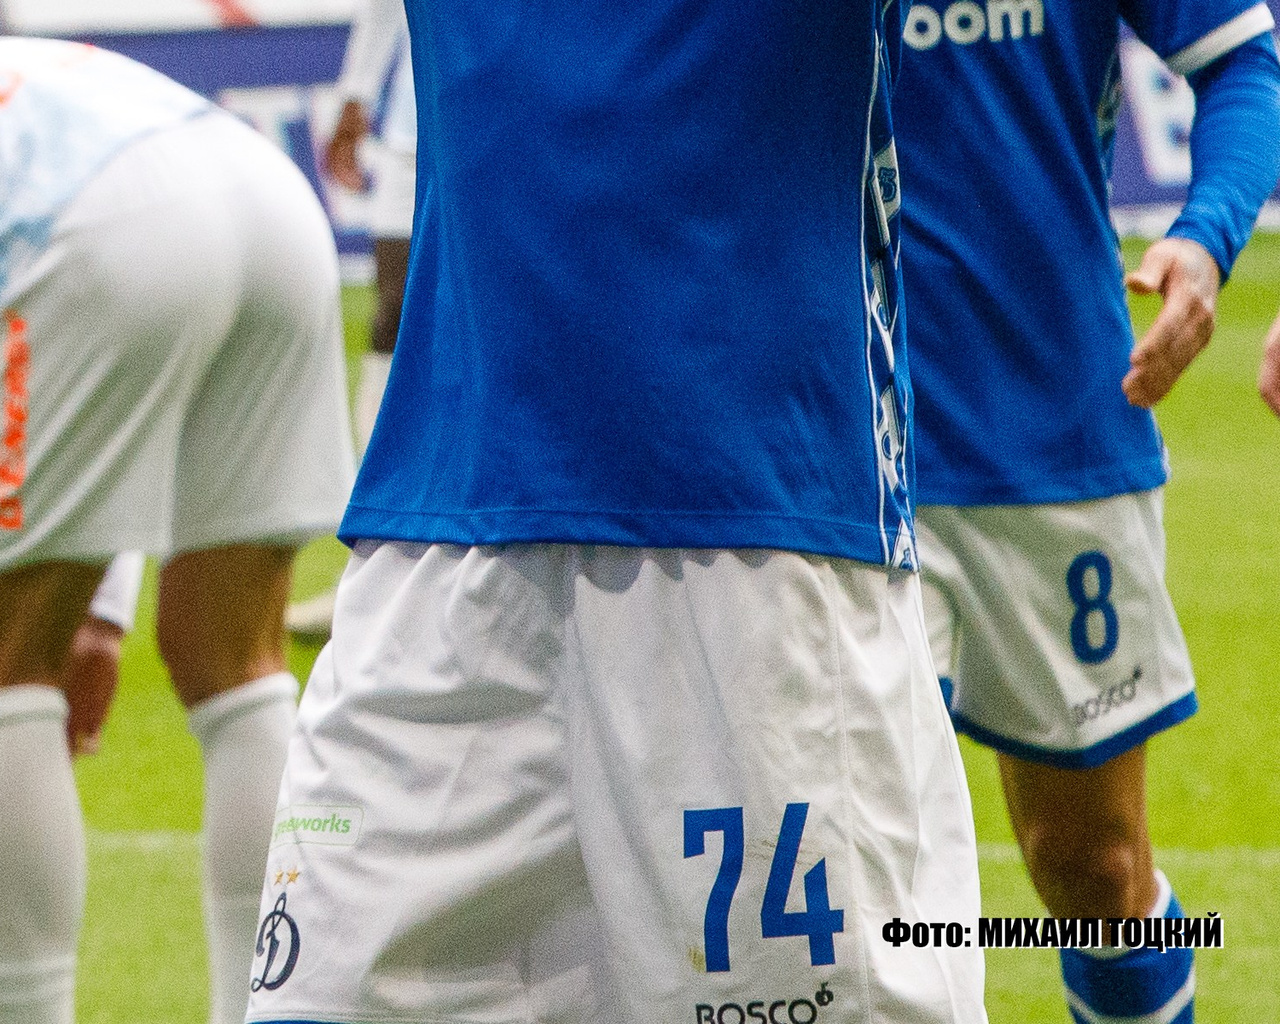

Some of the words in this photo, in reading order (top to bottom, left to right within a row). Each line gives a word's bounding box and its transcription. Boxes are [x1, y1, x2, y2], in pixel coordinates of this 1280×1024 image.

[1066, 550, 1118, 664] 8
[683, 802, 844, 973] 74
[695, 997, 818, 1024] BOSCO
